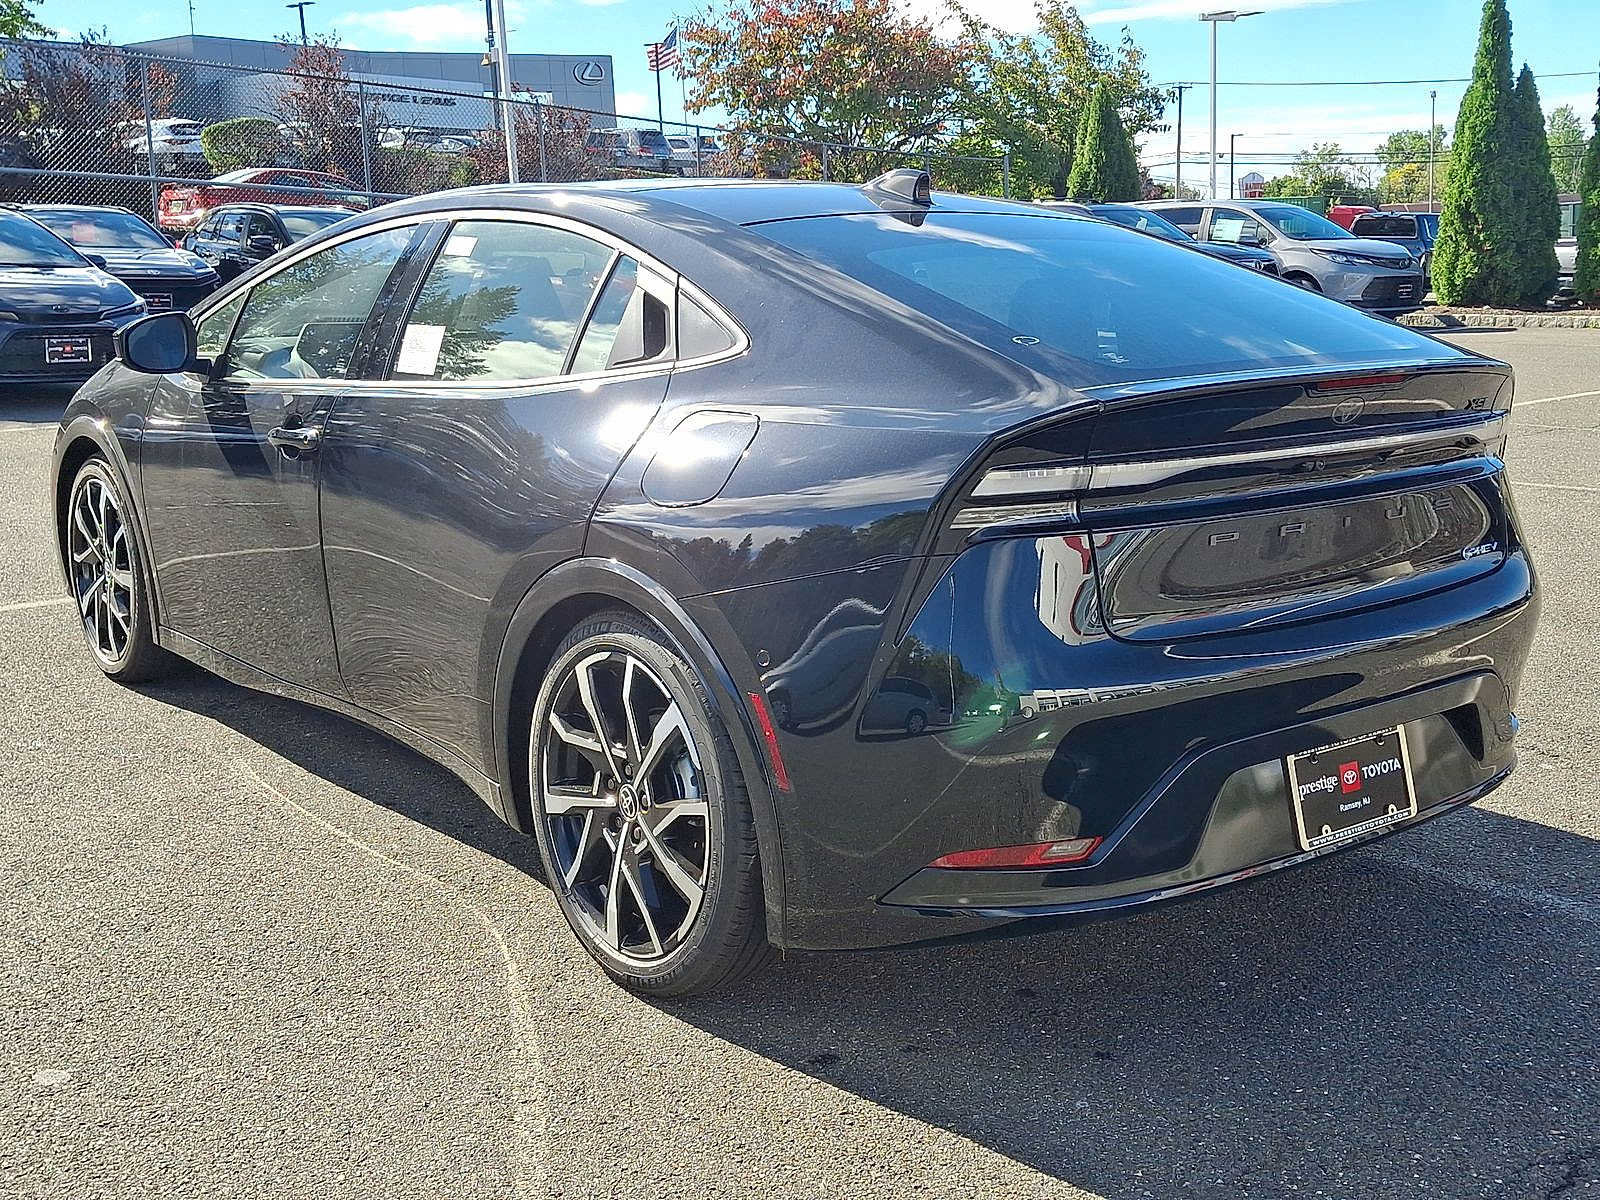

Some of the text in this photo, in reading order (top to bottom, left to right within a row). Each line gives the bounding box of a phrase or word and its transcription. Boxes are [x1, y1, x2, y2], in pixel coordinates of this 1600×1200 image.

[1298, 757, 1402, 800] prestige TOYOTA
[1339, 796, 1371, 812] Ramsey, NJ
